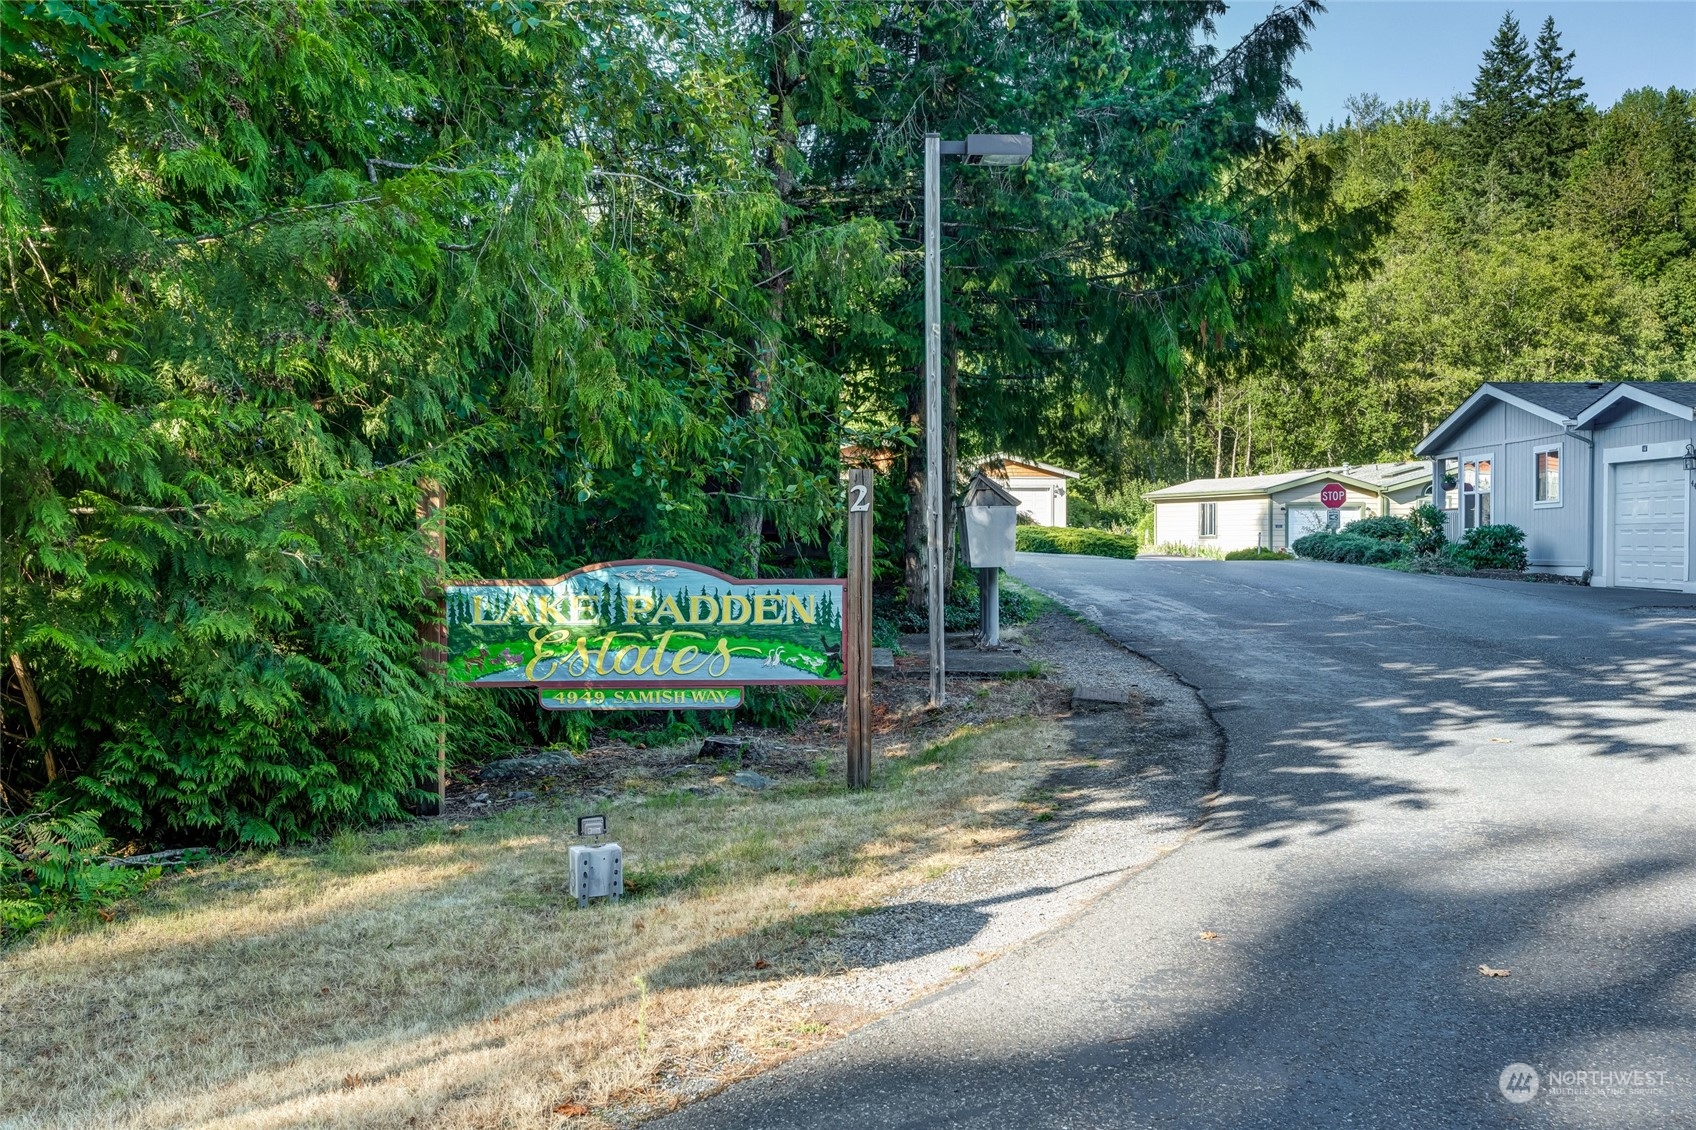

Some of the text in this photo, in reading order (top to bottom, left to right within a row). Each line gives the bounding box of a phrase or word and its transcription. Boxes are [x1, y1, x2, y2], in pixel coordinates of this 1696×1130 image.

[851, 485, 870, 512] 2
[1322, 491, 1345, 501] STOP
[470, 594, 817, 625] LAKE PADDEN
[525, 627, 762, 682] Estates
[554, 690, 730, 705] 4949 SAMISH WAY
